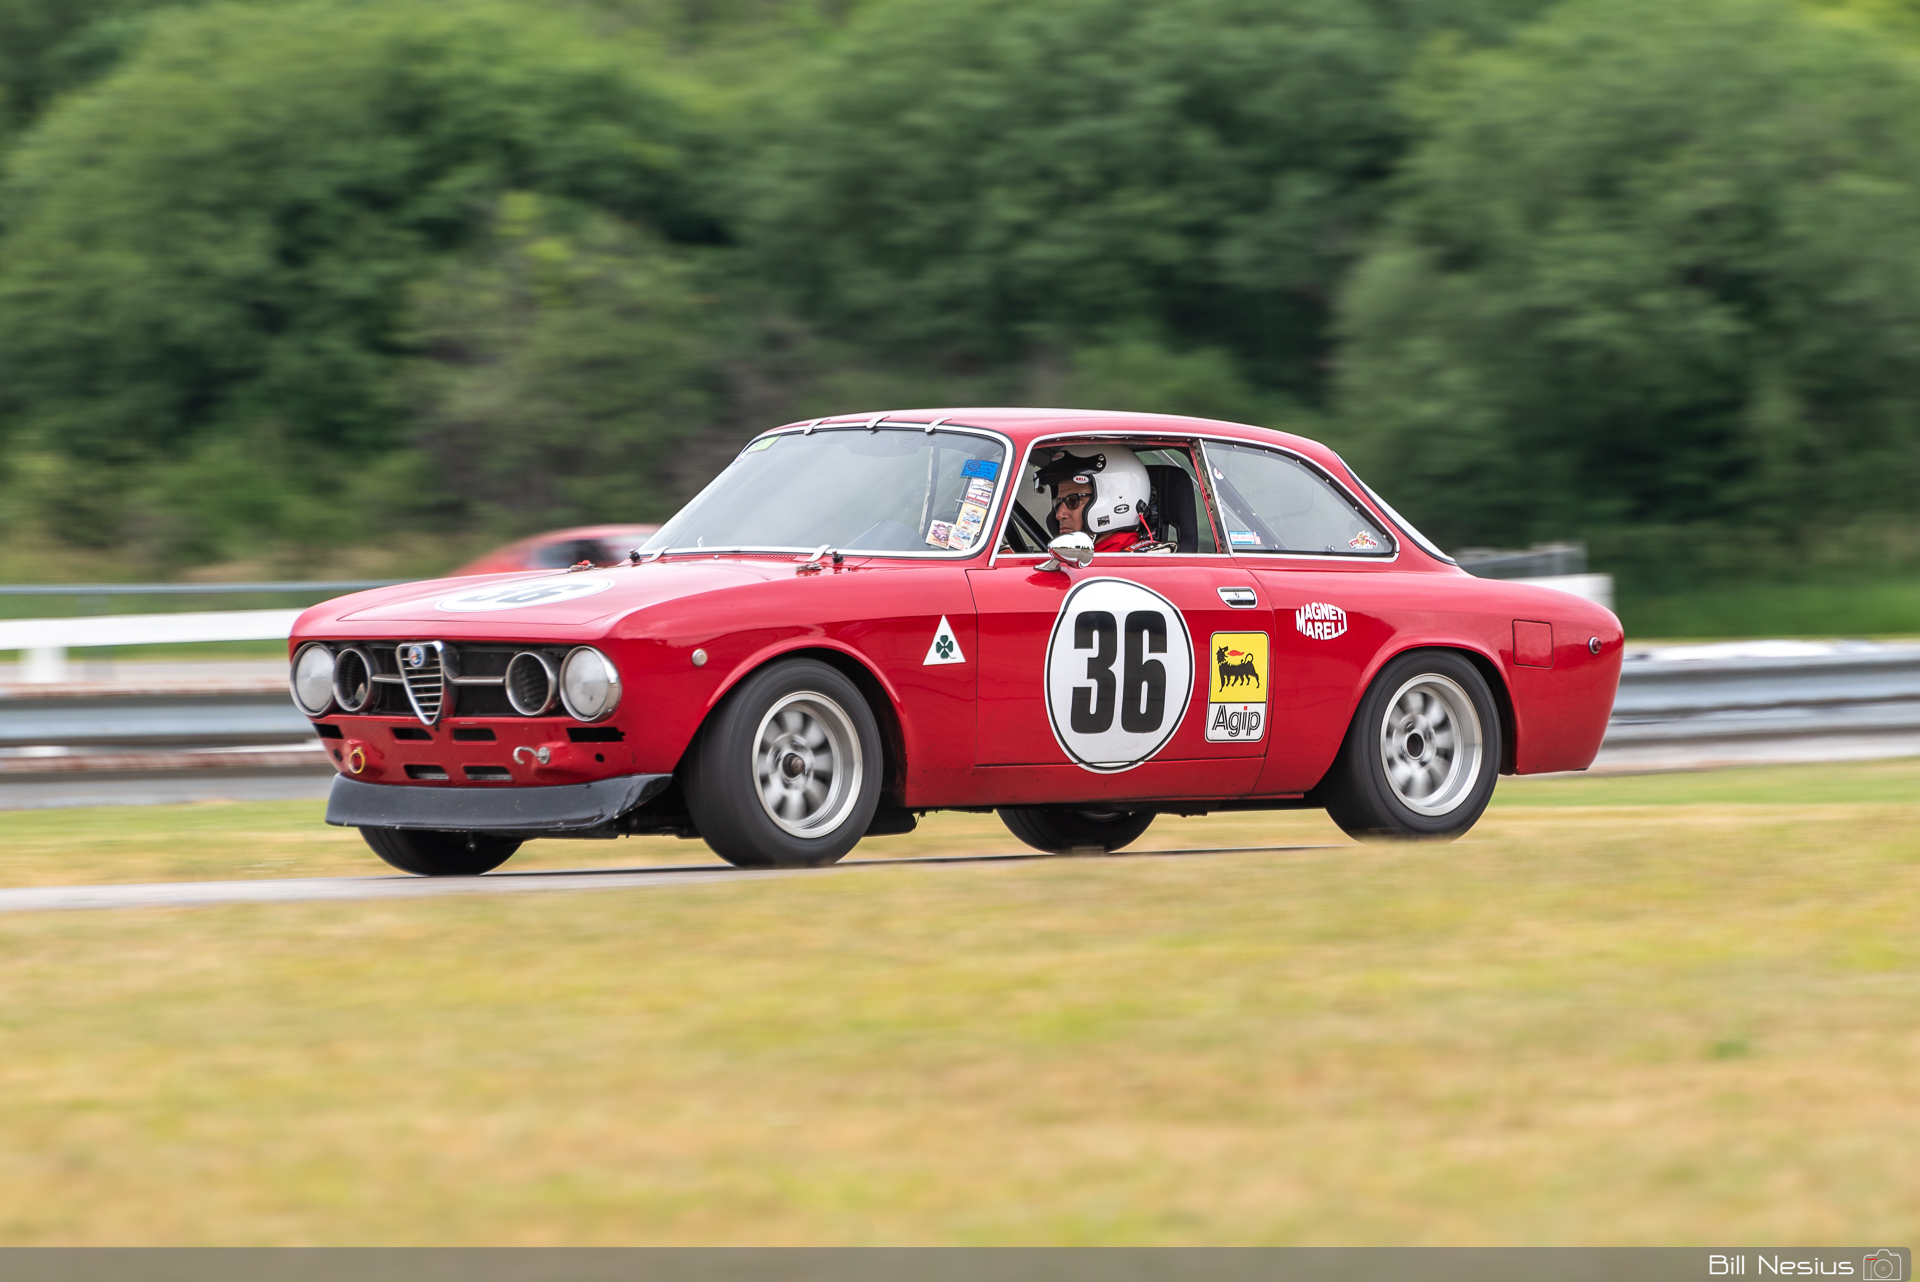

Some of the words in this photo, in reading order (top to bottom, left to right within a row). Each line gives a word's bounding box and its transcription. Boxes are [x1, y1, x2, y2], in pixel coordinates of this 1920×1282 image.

[1296, 602, 1347, 626] MAGNETI
[1296, 615, 1348, 641] MARELLI
[1070, 610, 1167, 734] 36
[1211, 705, 1261, 737] Agip
